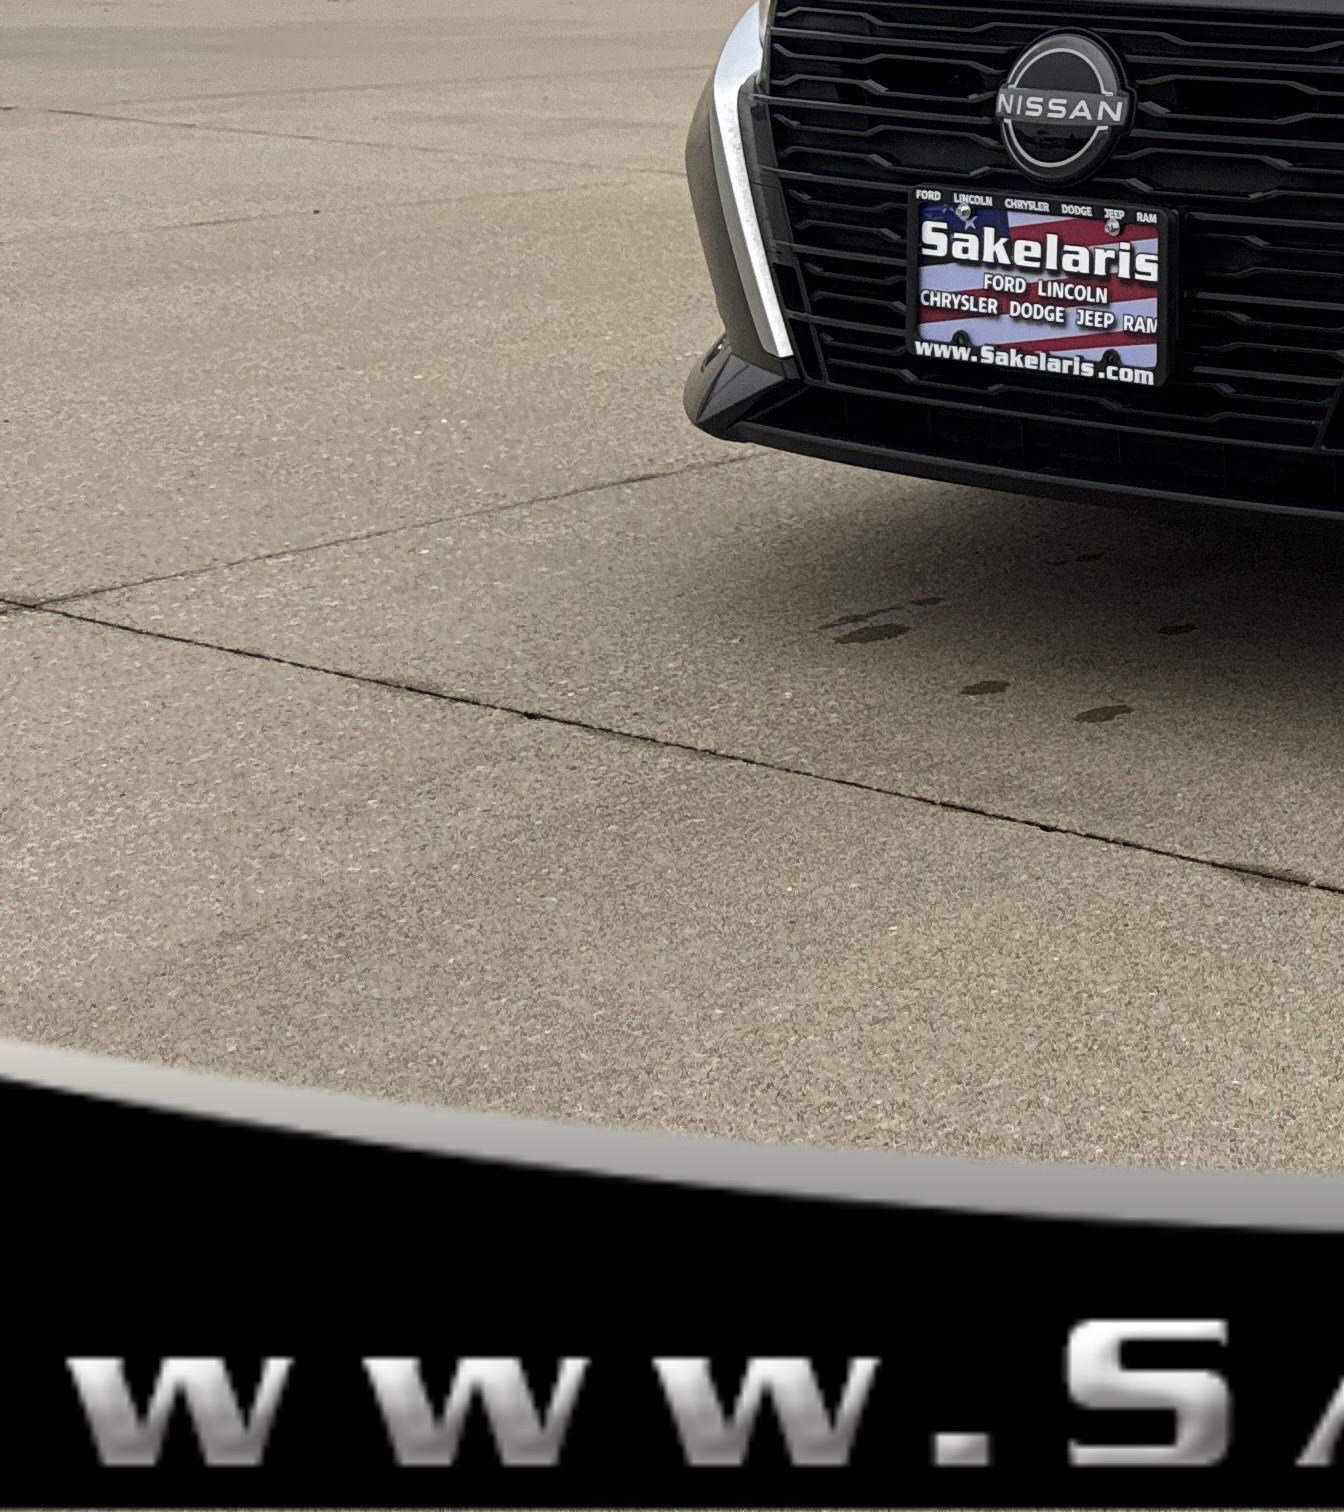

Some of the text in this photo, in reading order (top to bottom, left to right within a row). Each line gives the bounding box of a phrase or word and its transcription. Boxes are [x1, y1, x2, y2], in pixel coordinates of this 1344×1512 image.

[997, 92, 1123, 122] NISSAN
[915, 189, 942, 202] FORD
[953, 193, 993, 207] LINCOLN
[1004, 198, 1050, 213] CHRYSLER
[1061, 204, 1093, 217] DODGE
[1136, 211, 1158, 224] RAM
[921, 220, 1159, 282] Sakelaris
[984, 273, 1108, 304] FORD LINCOLN
[920, 289, 999, 315] CHRYSLER
[1009, 300, 1065, 324] DODGE
[1076, 308, 1115, 329] JEEP
